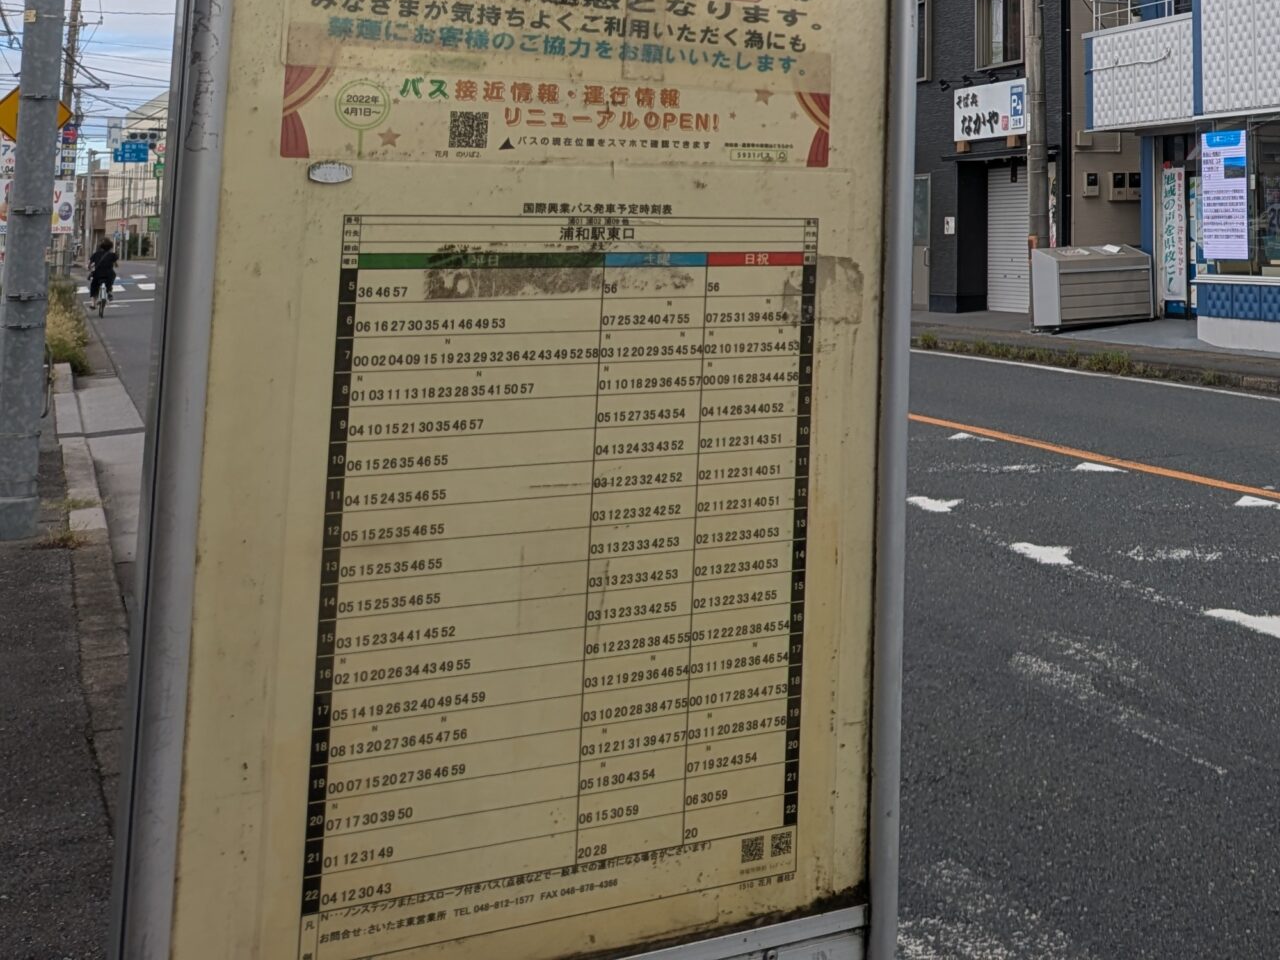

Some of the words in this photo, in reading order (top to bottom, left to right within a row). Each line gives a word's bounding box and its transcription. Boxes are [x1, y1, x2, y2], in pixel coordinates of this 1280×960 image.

[327, 15, 806, 76] 禁煙にお客様のご協力をお願いいたします。
[345, 94, 380, 105] 2022年
[961, 110, 999, 136] なかや
[523, 202, 673, 215] 国際興業バス発車予定時刻表
[559, 226, 636, 241] 浦和駅東口
[744, 253, 770, 266] 日祝
[358, 287, 372, 298] 36
[376, 287, 390, 297] 46
[393, 286, 408, 297] 57
[604, 284, 617, 294] 56
[707, 282, 720, 292] 56
[356, 321, 371, 332] 06
[374, 321, 388, 332] 16
[390, 321, 405, 331] 27
[407, 320, 423, 331] 30
[425, 320, 439, 330] 35
[442, 319, 455, 330] 41
[458, 319, 473, 330] 46
[475, 319, 489, 329] 49
[491, 318, 506, 329] 53
[602, 315, 615, 326] 07
[617, 315, 630, 325] 25
[632, 315, 646, 325] 32
[648, 314, 660, 324] 40
[662, 314, 675, 324] 47
[677, 313, 690, 323] 55
[706, 313, 718, 323] 07
[720, 313, 732, 323] 25
[734, 312, 746, 322] 31
[748, 312, 760, 322] 39
[762, 311, 774, 321] 46
[776, 311, 788, 321] 54
[353, 356, 368, 367] 00
[371, 355, 386, 366] 02
[388, 355, 403, 366] 04
[405, 354, 420, 365] 09
[424, 353, 437, 364] 15
[440, 353, 454, 364] 19
[457, 352, 471, 363] 23
[473, 352, 487, 363] 29
[490, 351, 503, 362] 32
[506, 351, 520, 362] 36
[522, 350, 536, 361] 42
[538, 350, 552, 360] 43
[554, 349, 567, 360] 49
[570, 349, 583, 359] 52
[585, 348, 599, 359] 58
[704, 344, 717, 354] 02
[719, 343, 731, 353] 10
[734, 343, 745, 353] 19
[747, 342, 759, 352] 27
[761, 342, 773, 352] 35
[774, 341, 786, 351] 44
[788, 341, 800, 351] 53
[351, 391, 366, 402] 01
[369, 390, 384, 401] 03
[388, 389, 400, 400] 11
[404, 388, 418, 399] 13
[421, 388, 435, 399] 18
[438, 387, 452, 398] 23
[455, 386, 469, 397] 28
[471, 385, 485, 396] 35
[488, 385, 501, 395] 41
[504, 384, 518, 395] 50
[520, 383, 534, 394] 57
[349, 425, 364, 436] 04
[368, 424, 382, 435] 10
[386, 423, 399, 434] 15
[402, 422, 415, 433] 21
[419, 421, 433, 433] 30
[435, 420, 450, 432] 35
[452, 420, 467, 431] 46
[469, 419, 484, 430] 57
[347, 460, 362, 471] 06
[366, 459, 379, 470] 15
[382, 458, 397, 469] 26
[400, 457, 414, 468] 35
[417, 456, 431, 467] 46
[434, 455, 448, 466] 55
[321, 893, 337, 906] 04
[341, 889, 355, 902] 12
[358, 886, 374, 898] 30
[376, 883, 391, 895] 43
[578, 846, 591, 859] 20
[593, 844, 607, 856] 28
[685, 828, 698, 839] 20
[454, 907, 471, 917] TEL
[540, 889, 558, 901] FAX
